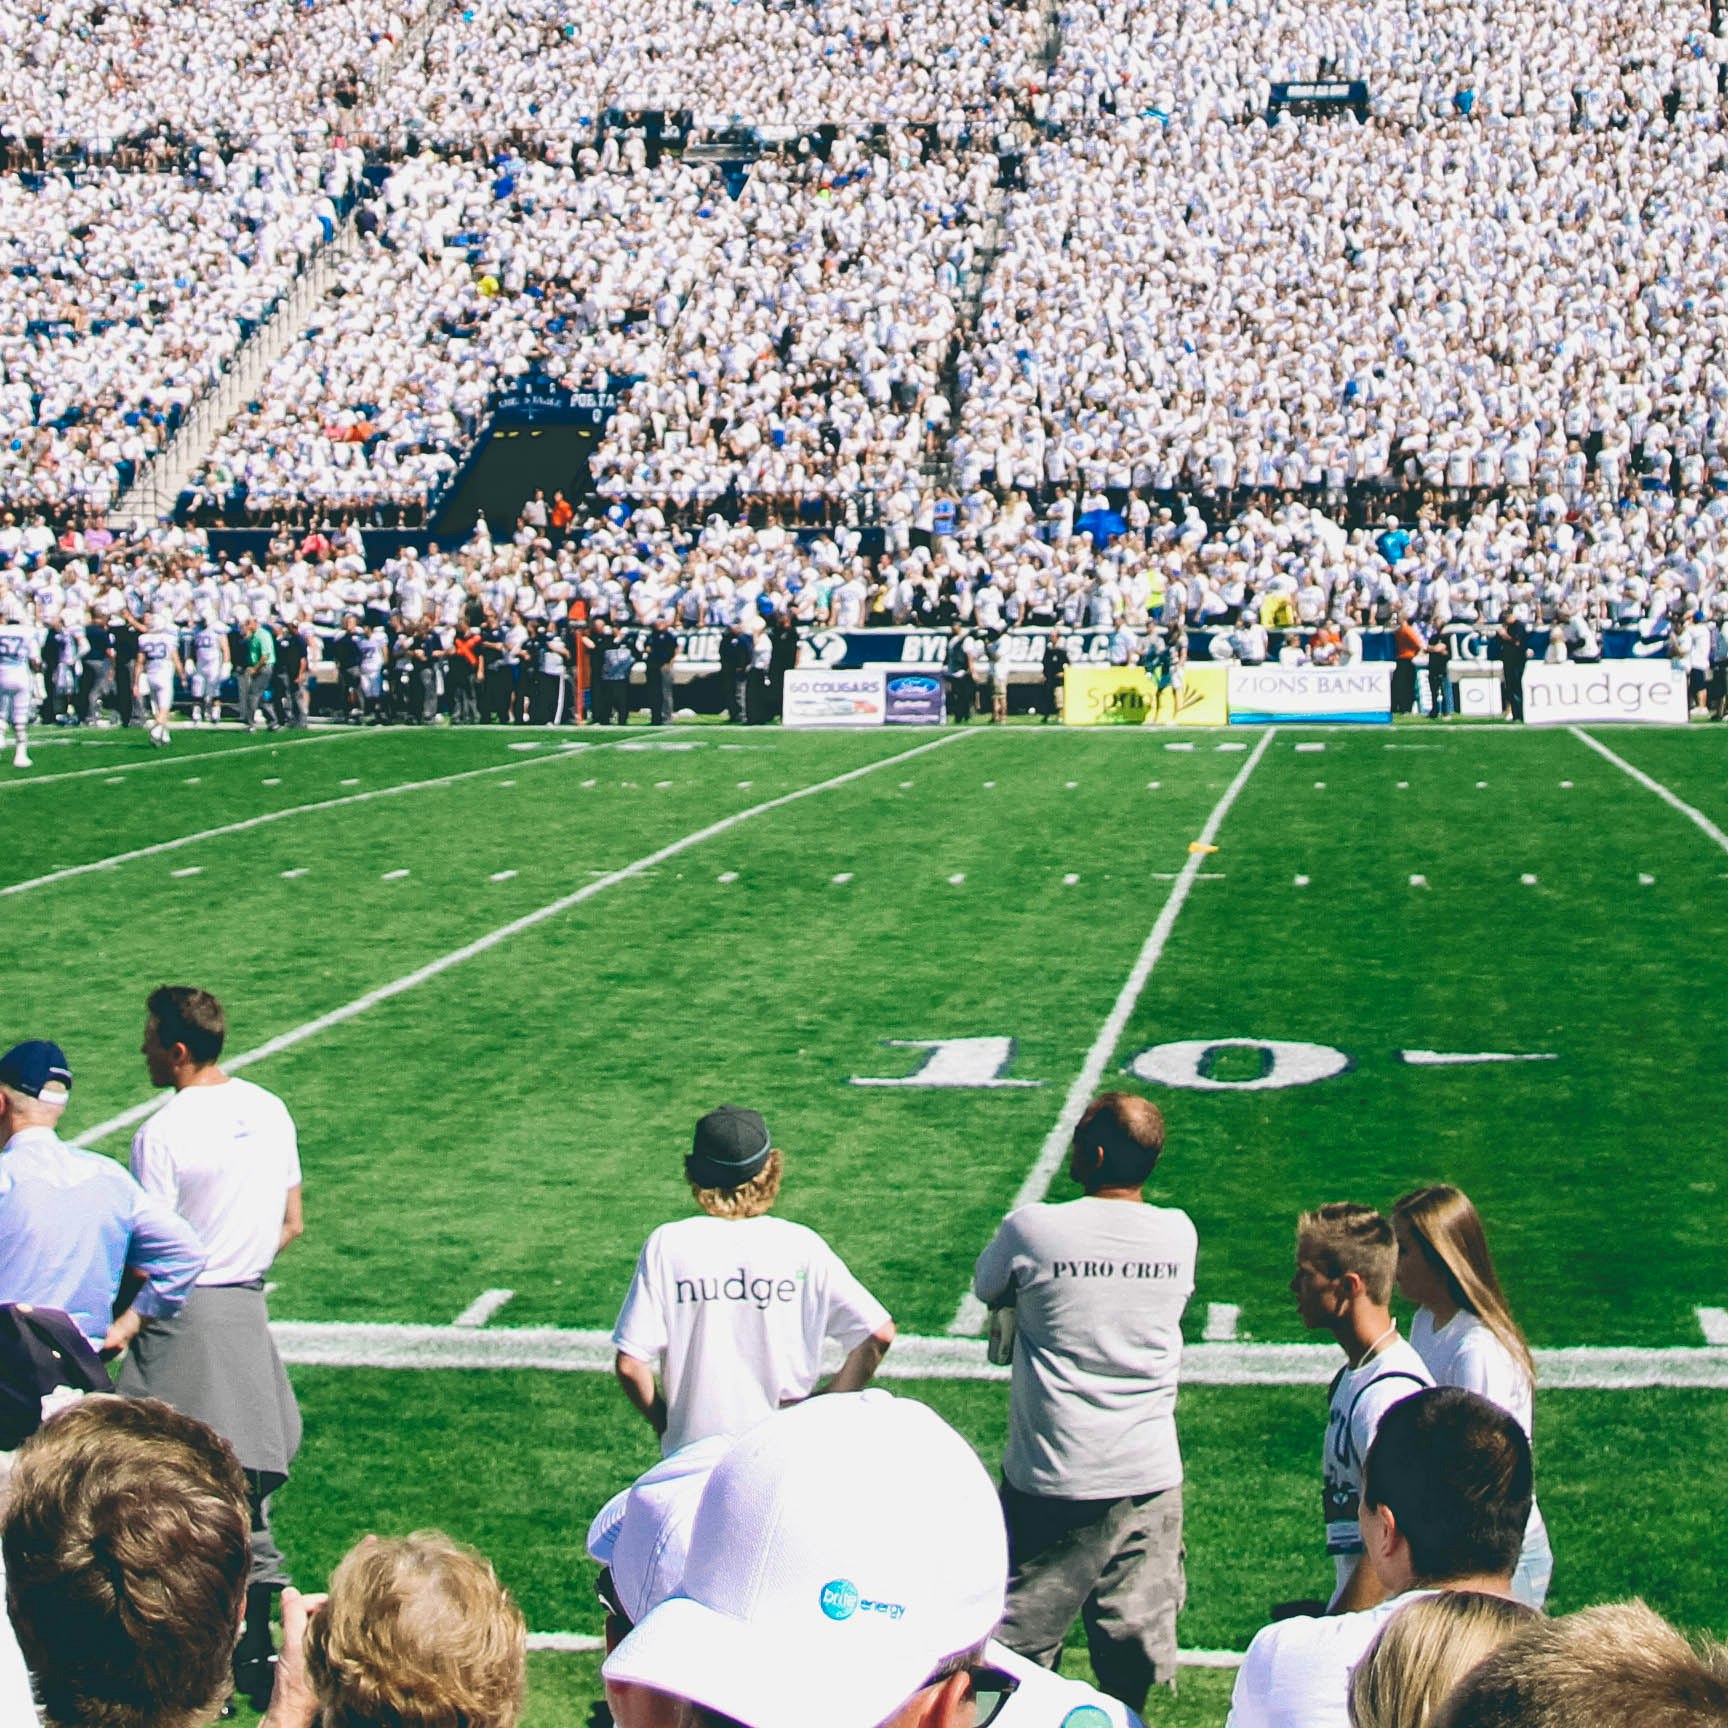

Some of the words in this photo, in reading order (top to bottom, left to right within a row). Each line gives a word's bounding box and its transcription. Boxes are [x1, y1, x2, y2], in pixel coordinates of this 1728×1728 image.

[812, 681, 881, 694] COUGARS
[1235, 676, 1309, 695] ZIONS
[1317, 675, 1383, 694] BANK
[1529, 673, 1673, 712] nudge
[1087, 686, 1155, 710] Sprin
[1052, 1260, 1115, 1279] PYRO
[1121, 1260, 1182, 1280] CREW
[675, 1267, 797, 1310] nudge
[860, 1598, 906, 1621] energy
